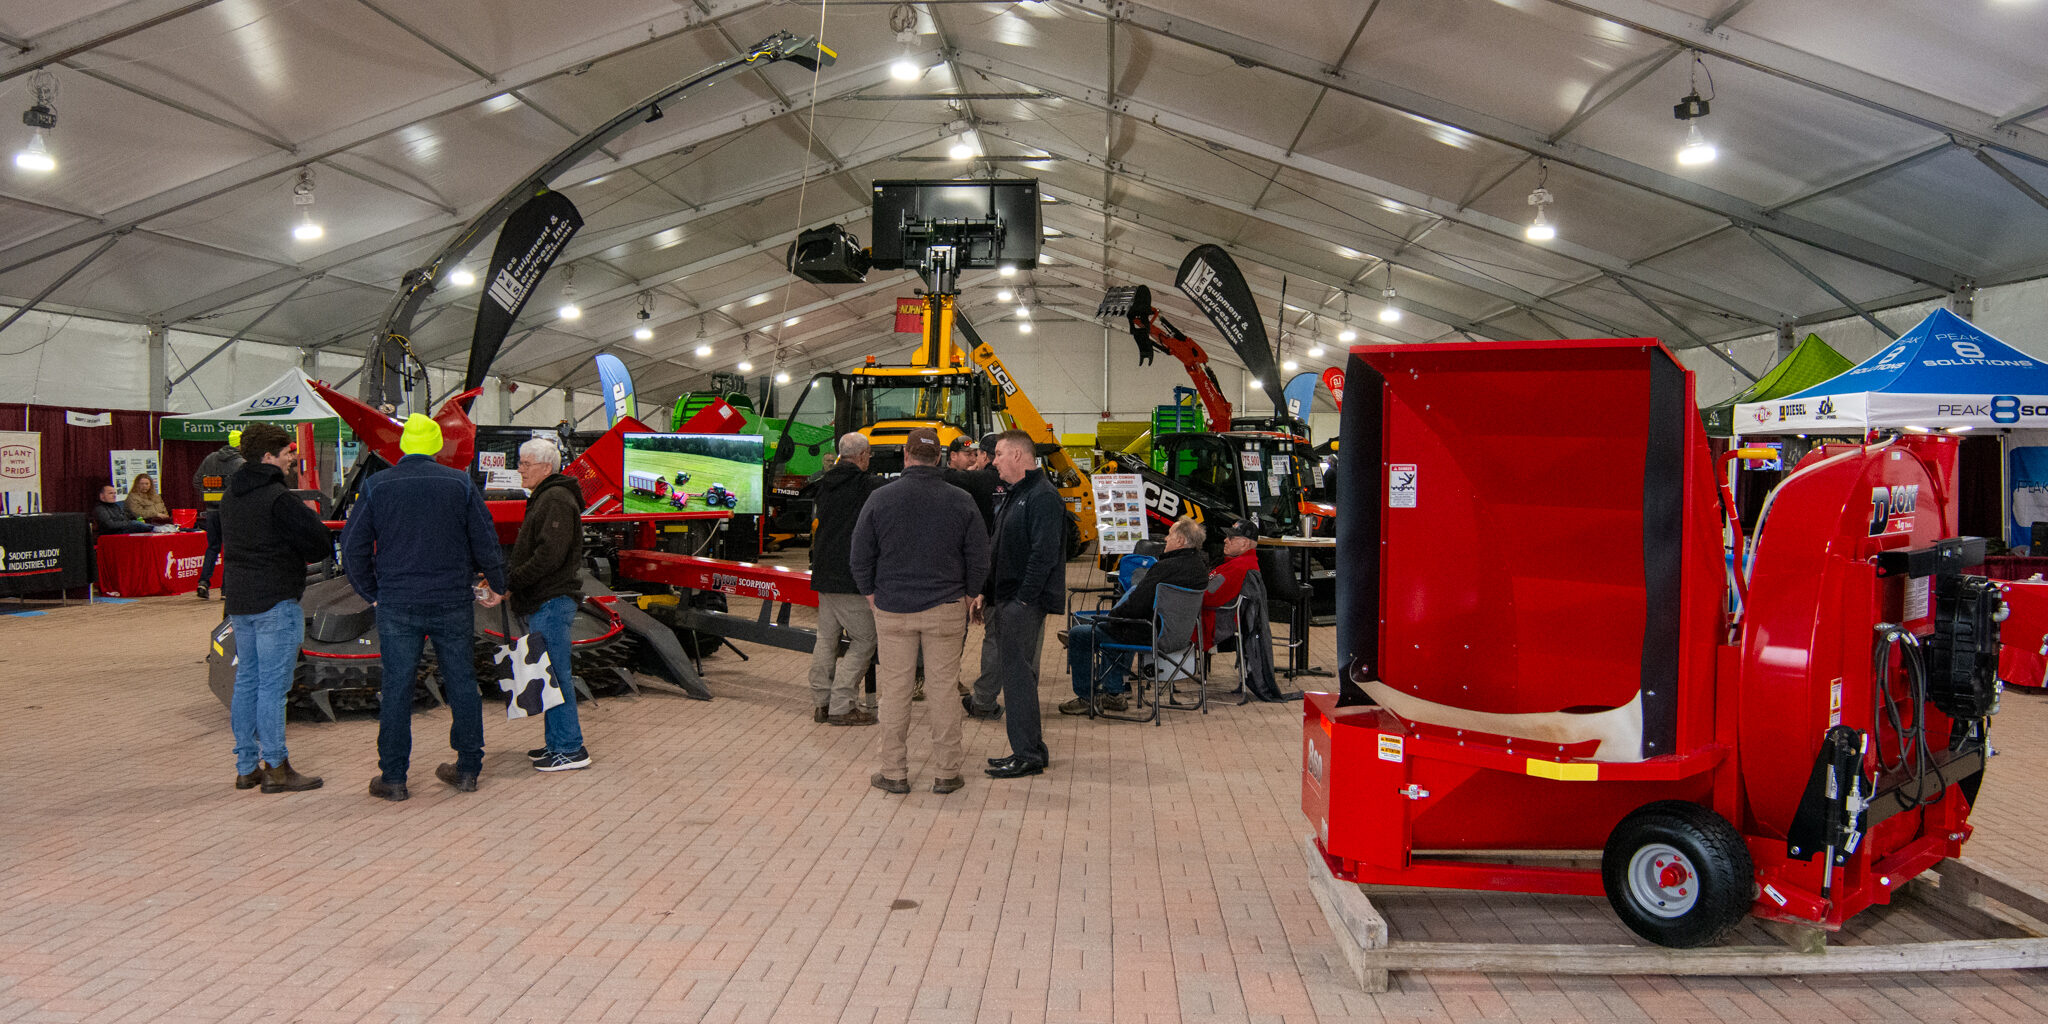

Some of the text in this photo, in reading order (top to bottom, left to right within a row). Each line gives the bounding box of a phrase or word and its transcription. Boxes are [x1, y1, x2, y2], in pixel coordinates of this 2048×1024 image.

[550, 215, 559, 226] &
[552, 219, 570, 240] Inc.
[509, 226, 573, 315] MILWAUKEE MADISON
[1230, 323, 1244, 342] Inc.
[1241, 322, 1249, 331] &
[1935, 333, 1983, 342] PEAK
[1952, 342, 1985, 359] 8
[1923, 359, 2033, 368] SOLUTIONS
[989, 364, 1017, 396] JCB
[250, 395, 299, 408] USDA
[1786, 404, 1807, 416] DIESEL
[183, 422, 215, 433] Farm
[1143, 481, 1179, 517] CB
[1868, 485, 1918, 537] DION
[9, 551, 32, 560] SADOFF
[39, 548, 60, 558] RUDOY
[9, 559, 58, 570] INDUSTRIES, LLP
[178, 569, 198, 578] SEEDS
[712, 573, 738, 590] DION
[739, 578, 771, 590] SCORPION
